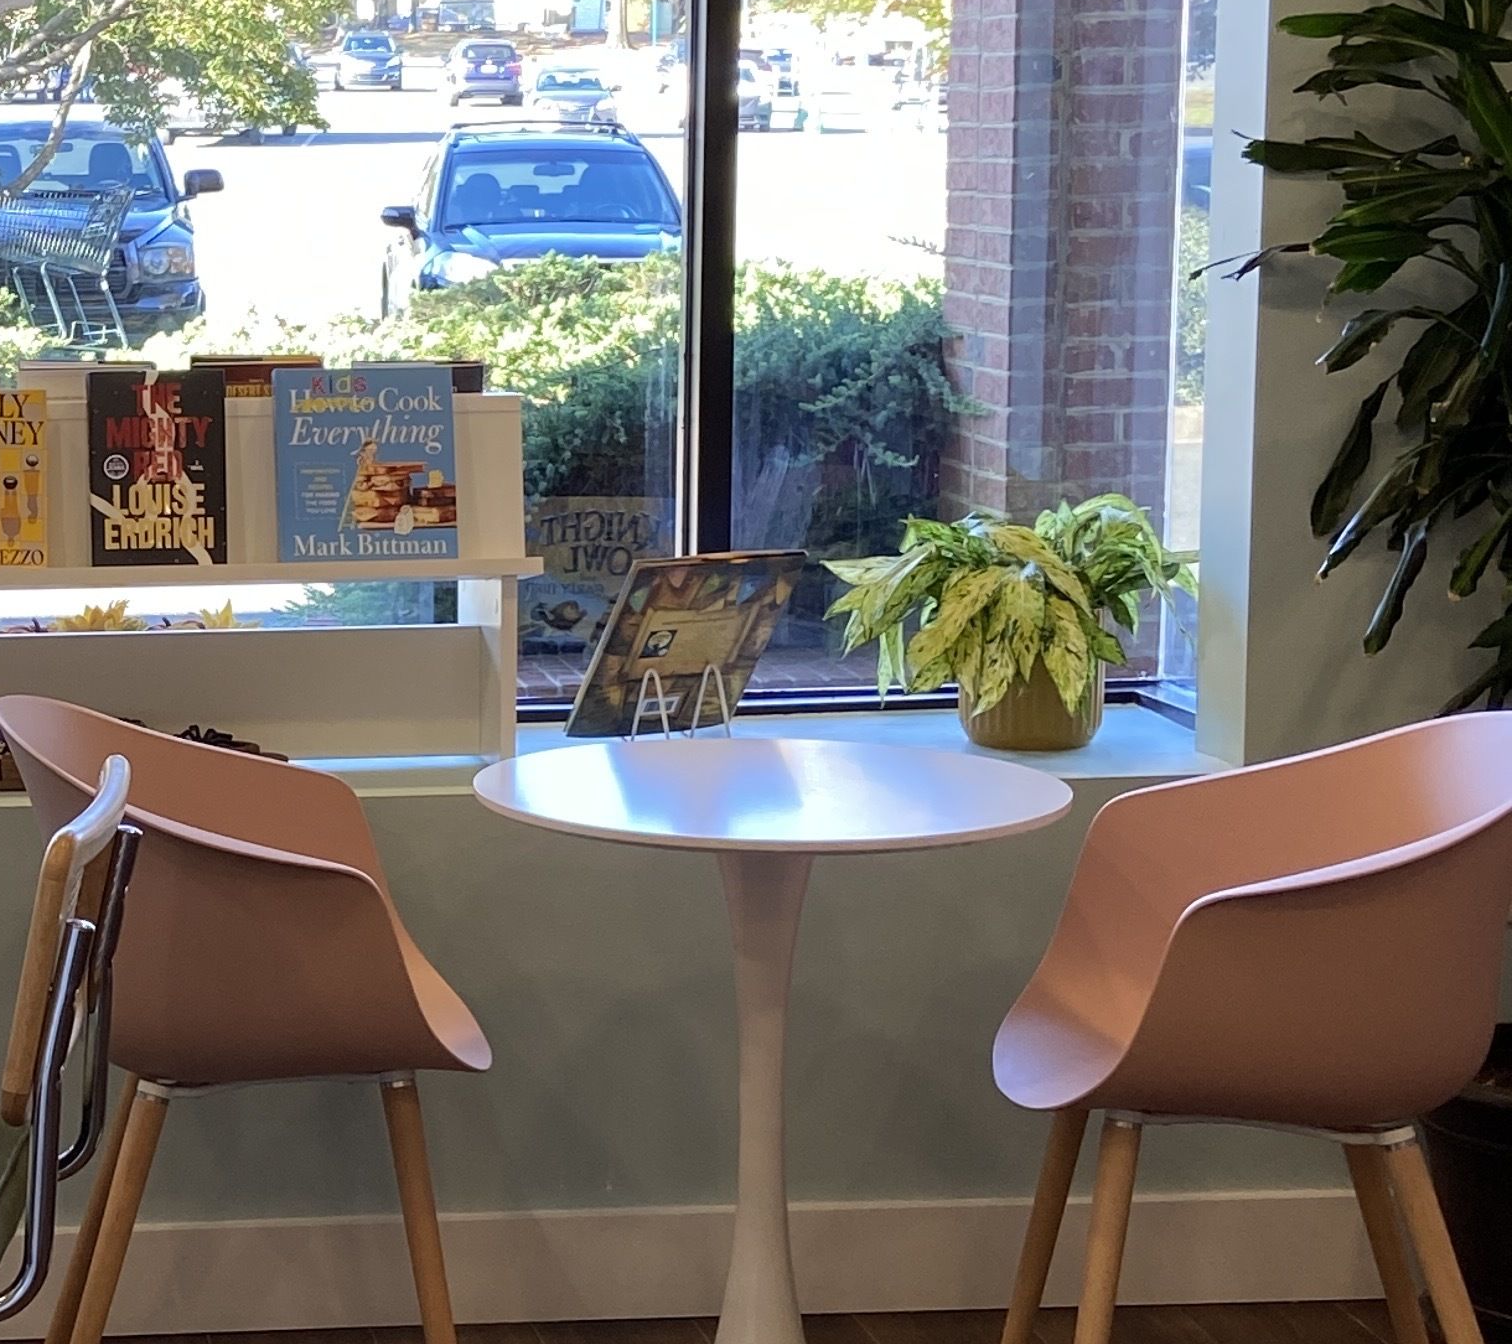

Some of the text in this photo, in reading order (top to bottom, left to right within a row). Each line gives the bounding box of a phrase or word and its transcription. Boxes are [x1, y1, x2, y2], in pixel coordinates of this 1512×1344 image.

[132, 383, 182, 415] THE
[311, 374, 368, 396] Kids
[378, 386, 443, 413] Cook
[105, 416, 213, 449] MIGHTY
[288, 414, 445, 455] Everything
[133, 450, 184, 481] RED
[112, 483, 206, 516] LOUISE
[104, 517, 215, 550] ERDRICH
[293, 533, 448, 557] Mark Bittman
